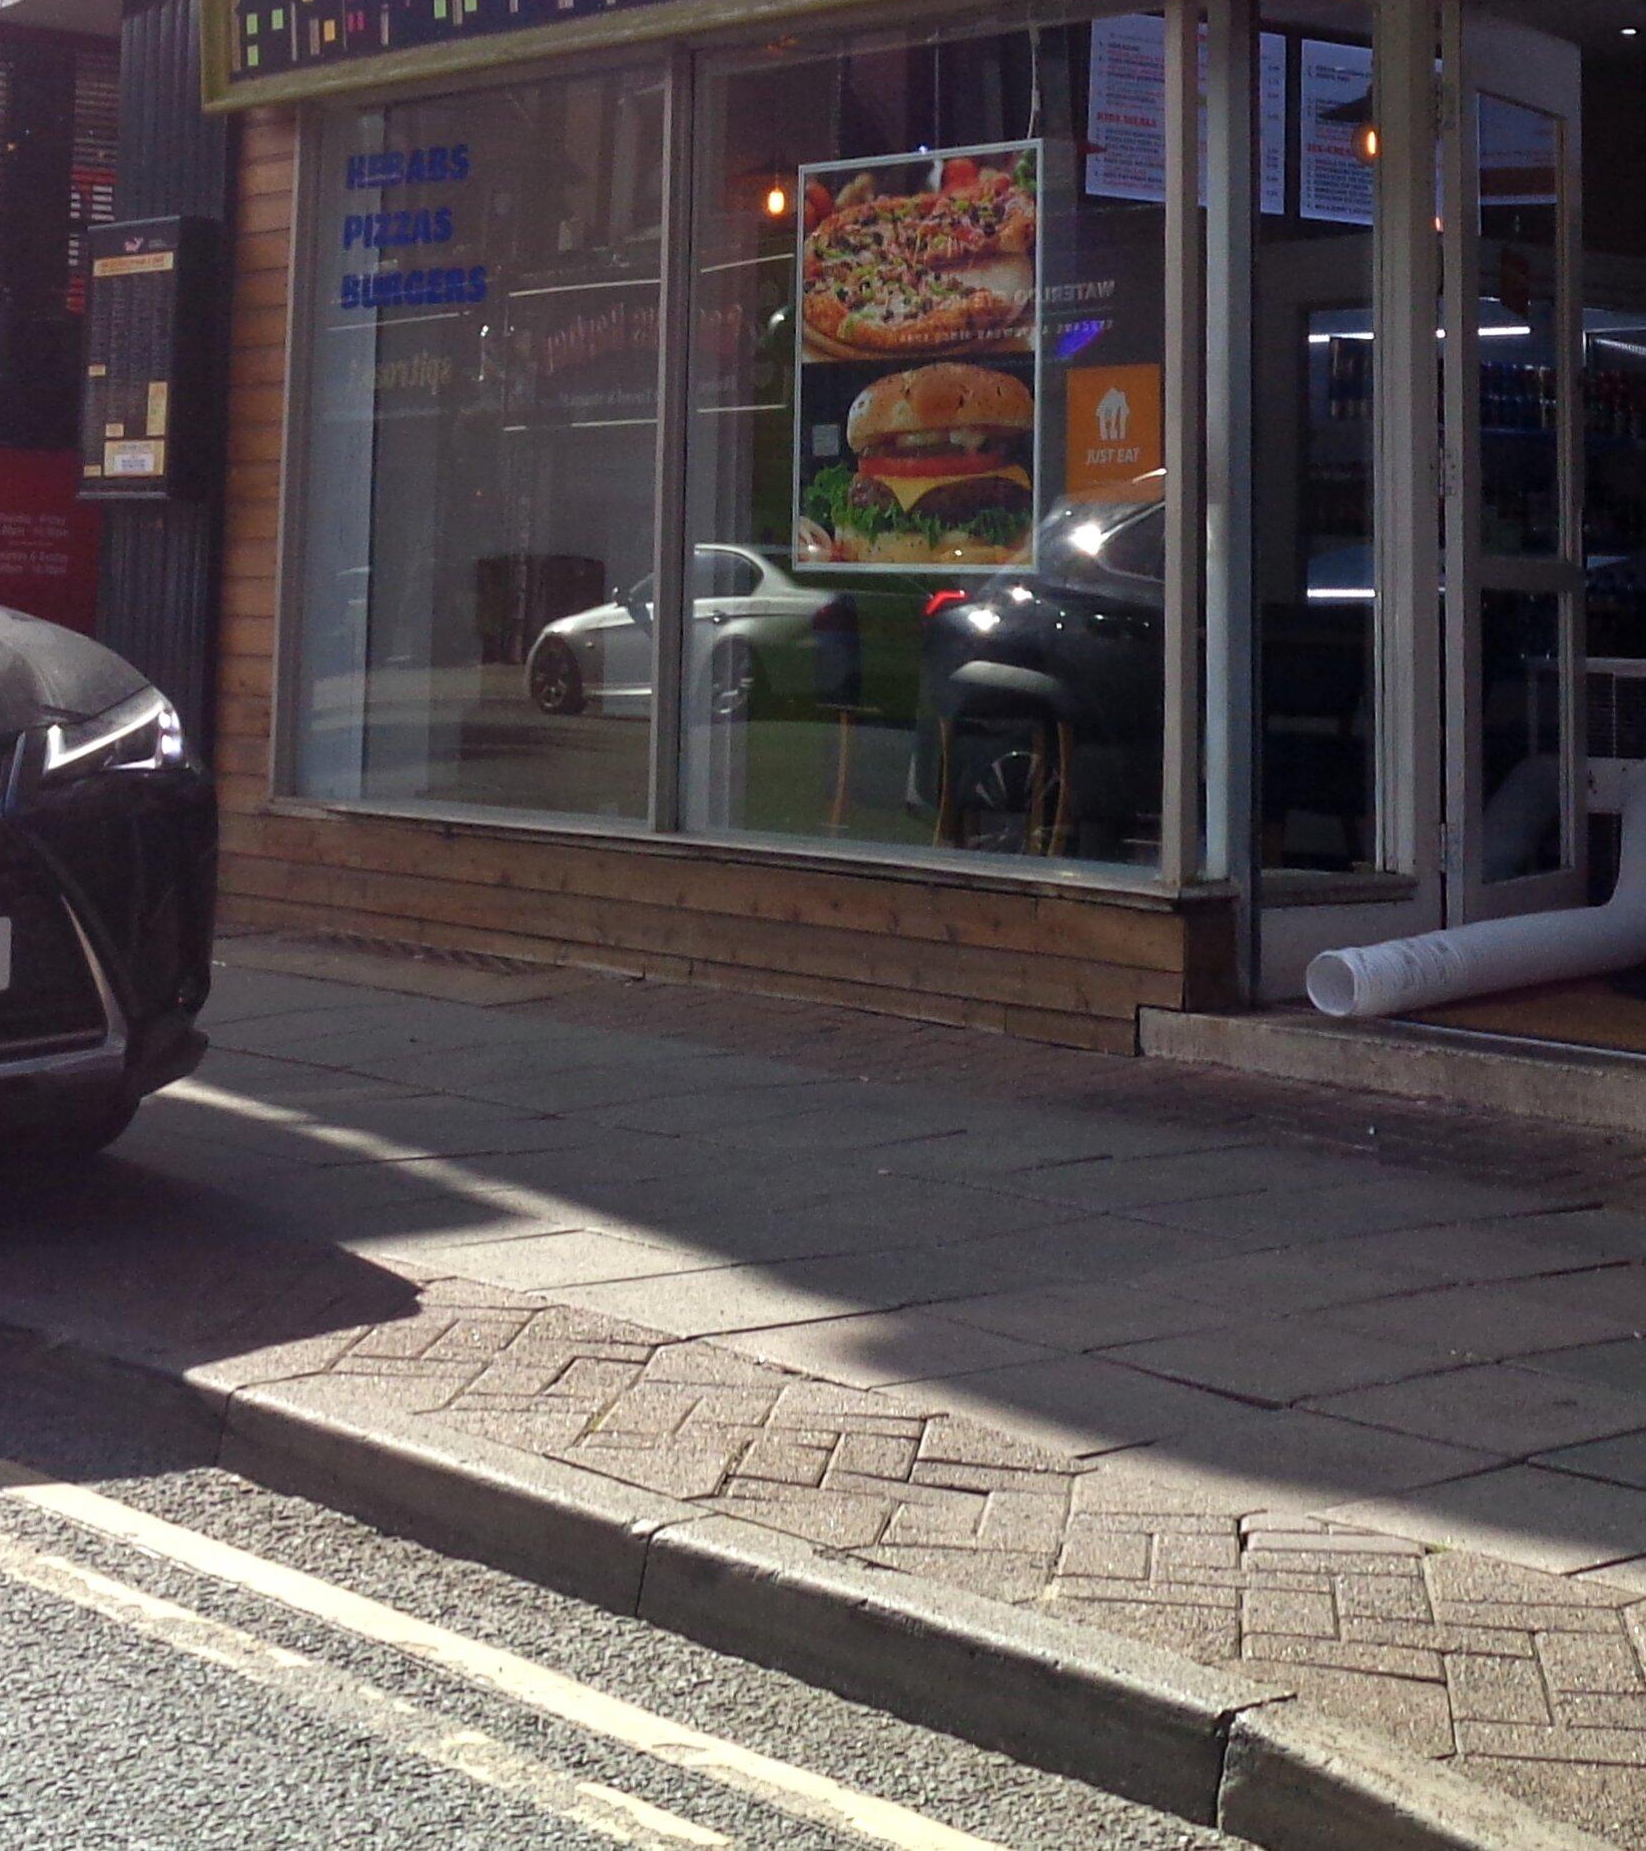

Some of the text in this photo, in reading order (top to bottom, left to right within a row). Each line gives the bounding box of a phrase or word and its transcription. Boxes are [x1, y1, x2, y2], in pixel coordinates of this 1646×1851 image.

[345, 143, 470, 190] KEBABS
[343, 206, 453, 250] PIZZAS
[340, 264, 489, 310] BURGERS
[1086, 445, 1141, 466] JUST EAT
